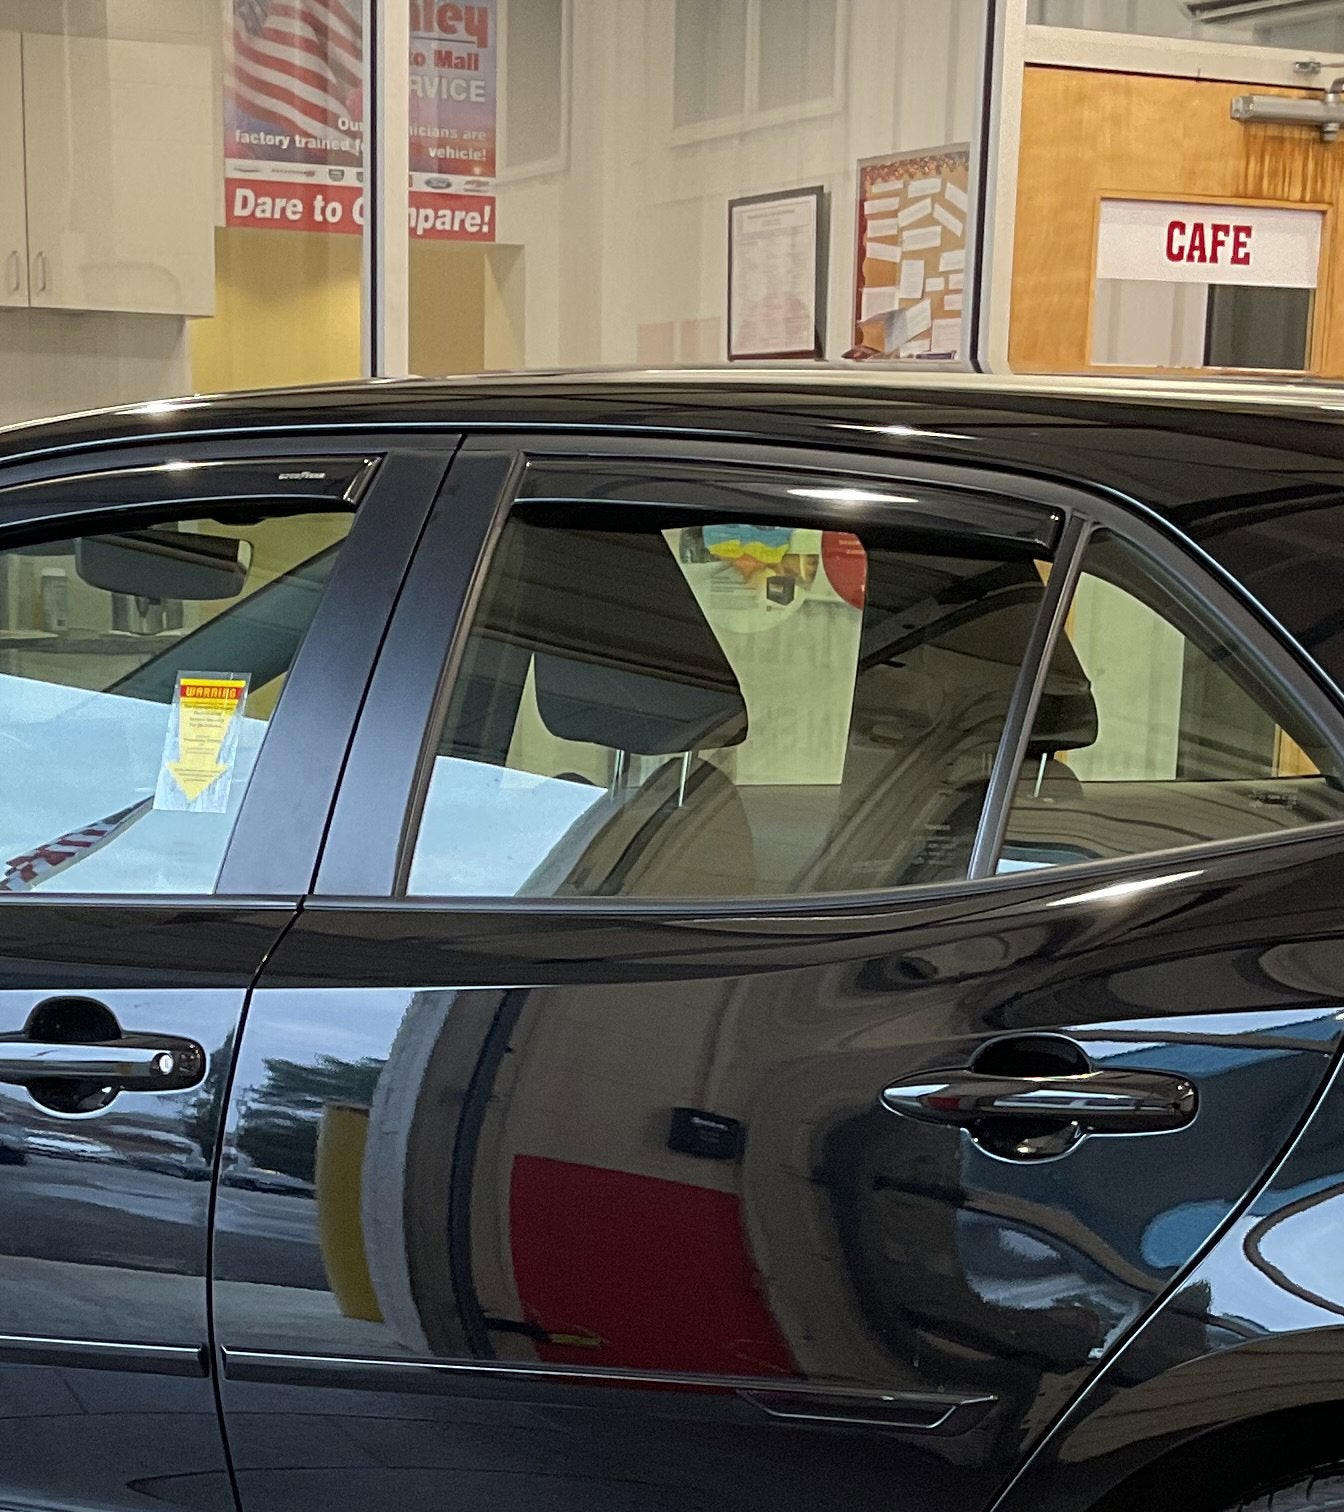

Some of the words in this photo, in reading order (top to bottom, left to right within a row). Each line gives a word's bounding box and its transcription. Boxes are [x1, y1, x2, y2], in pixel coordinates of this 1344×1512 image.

[434, 49, 480, 71] Mall
[235, 129, 291, 149] factory
[295, 134, 350, 151] trained
[428, 145, 487, 161] vehicle!
[462, 129, 487, 141] are
[233, 188, 304, 221] Dare
[313, 194, 344, 223] to
[1166, 220, 1253, 266] CAFE
[185, 686, 237, 699] WARNING
